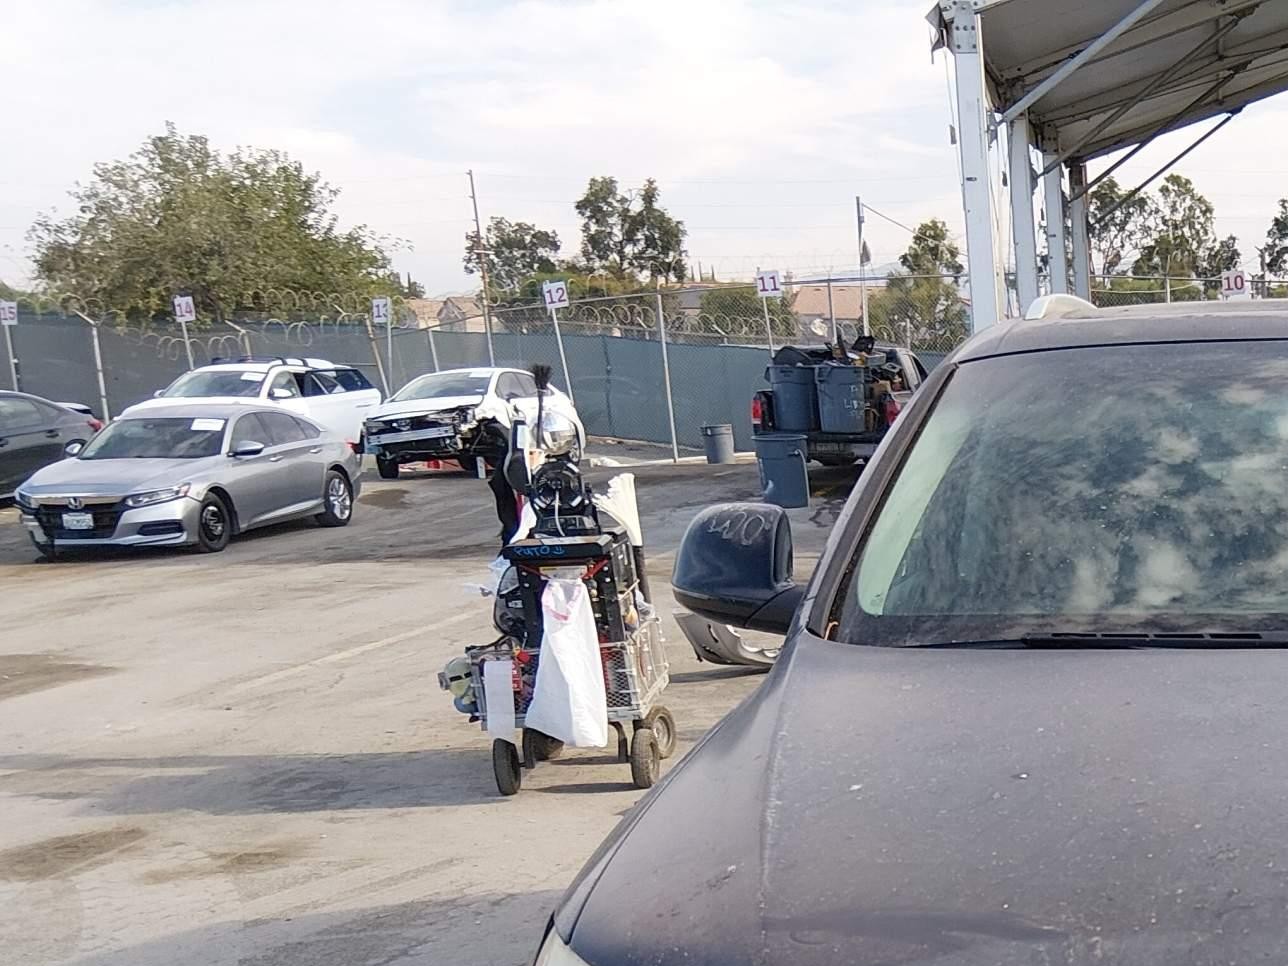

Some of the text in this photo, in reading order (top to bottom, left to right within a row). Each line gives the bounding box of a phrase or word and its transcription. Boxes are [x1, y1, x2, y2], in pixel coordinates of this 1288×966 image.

[758, 275, 780, 292] 11
[1223, 275, 1244, 291] 10
[546, 287, 567, 304] 12
[1, 306, 17, 321] 15
[176, 302, 193, 318] 14
